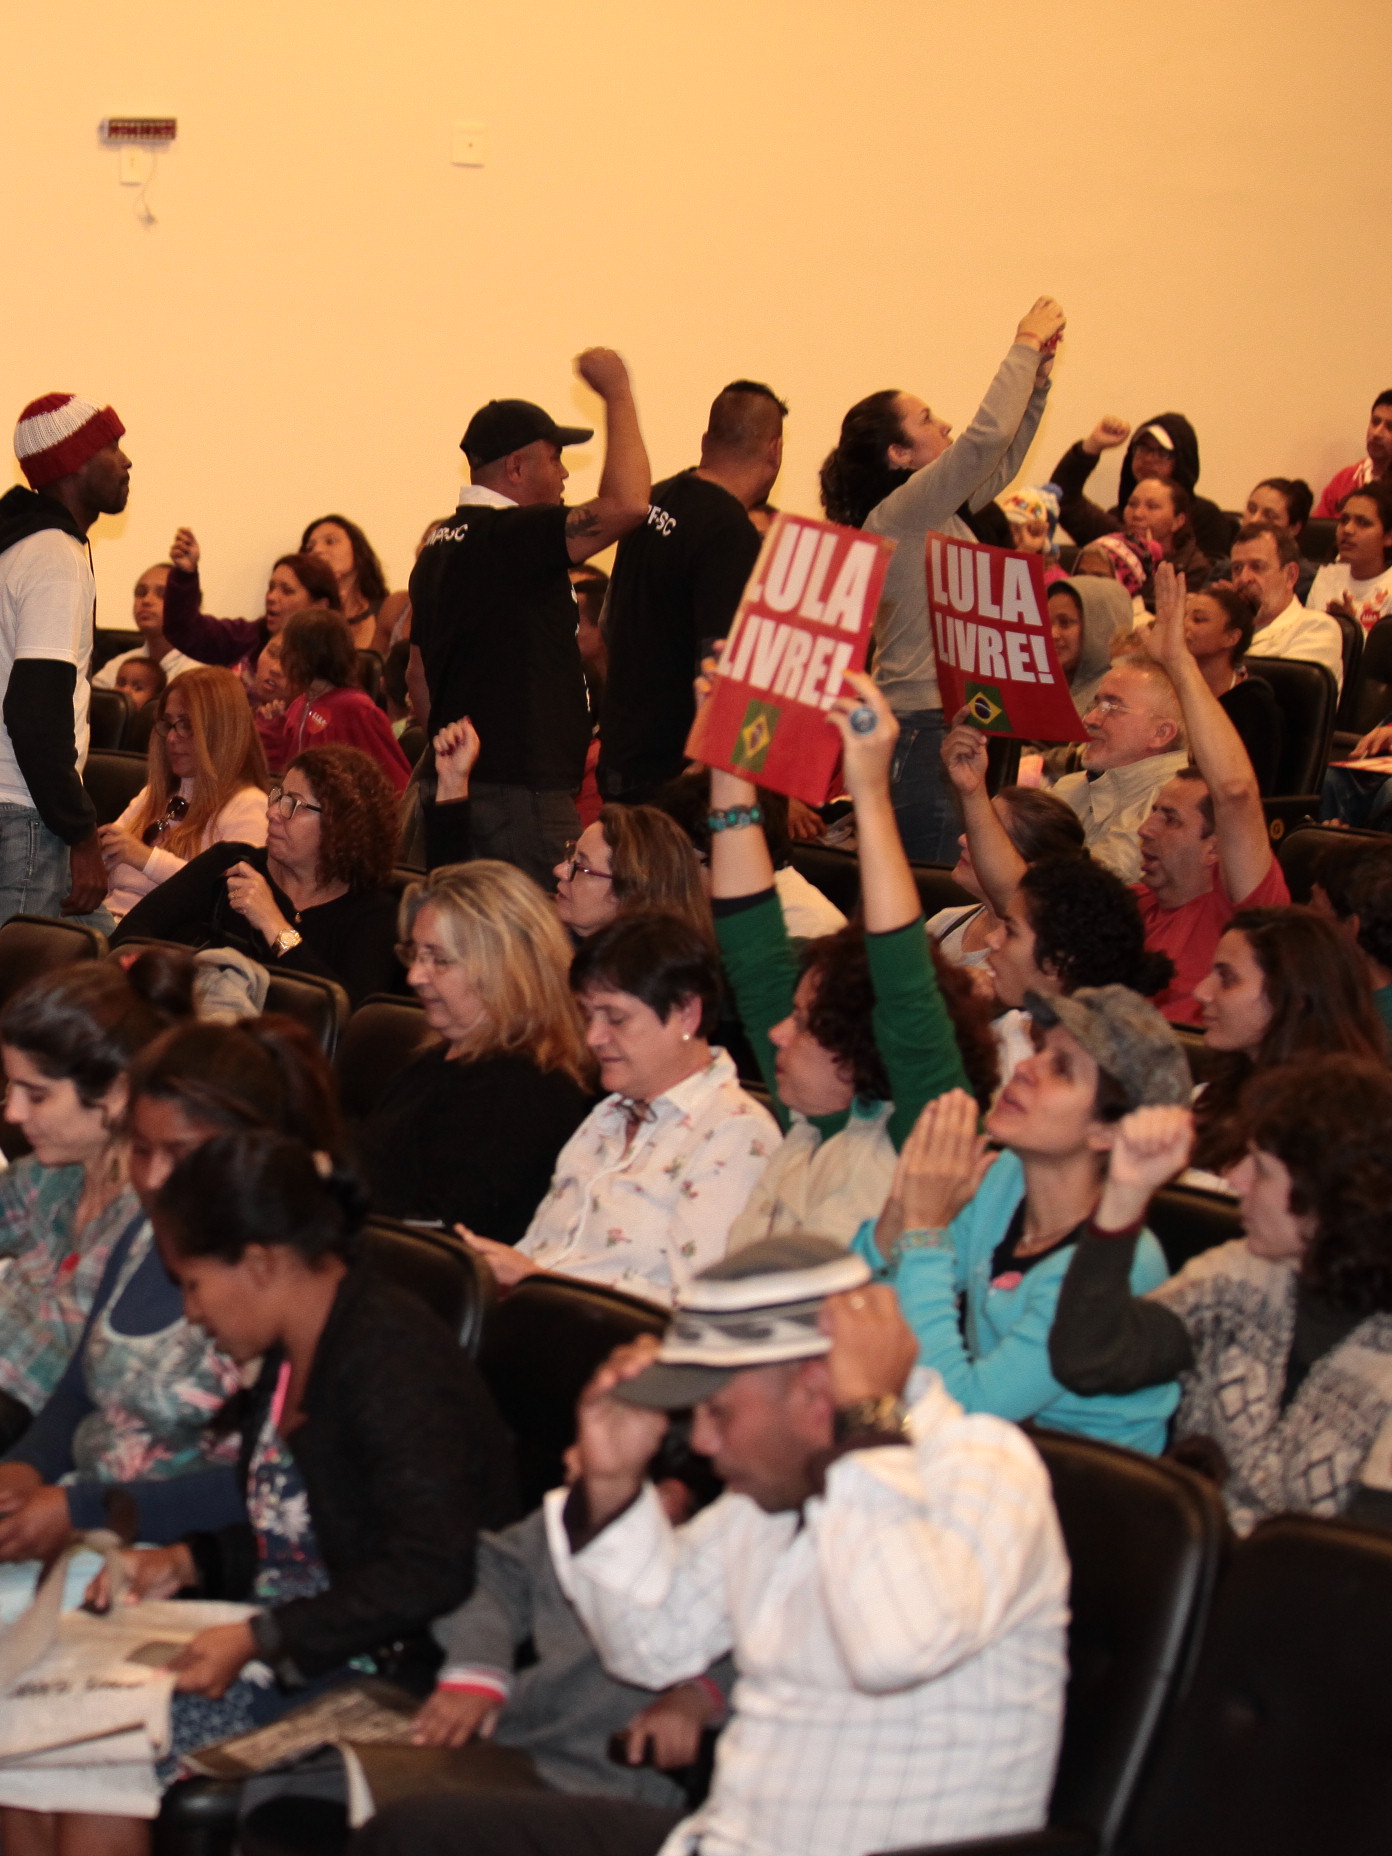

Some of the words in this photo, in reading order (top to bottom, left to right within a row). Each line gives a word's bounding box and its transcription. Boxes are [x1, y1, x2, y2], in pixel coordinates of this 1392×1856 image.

[750, 522, 878, 634] ULA
[931, 538, 1043, 627] LULA
[935, 610, 1056, 685] LIVRE!
